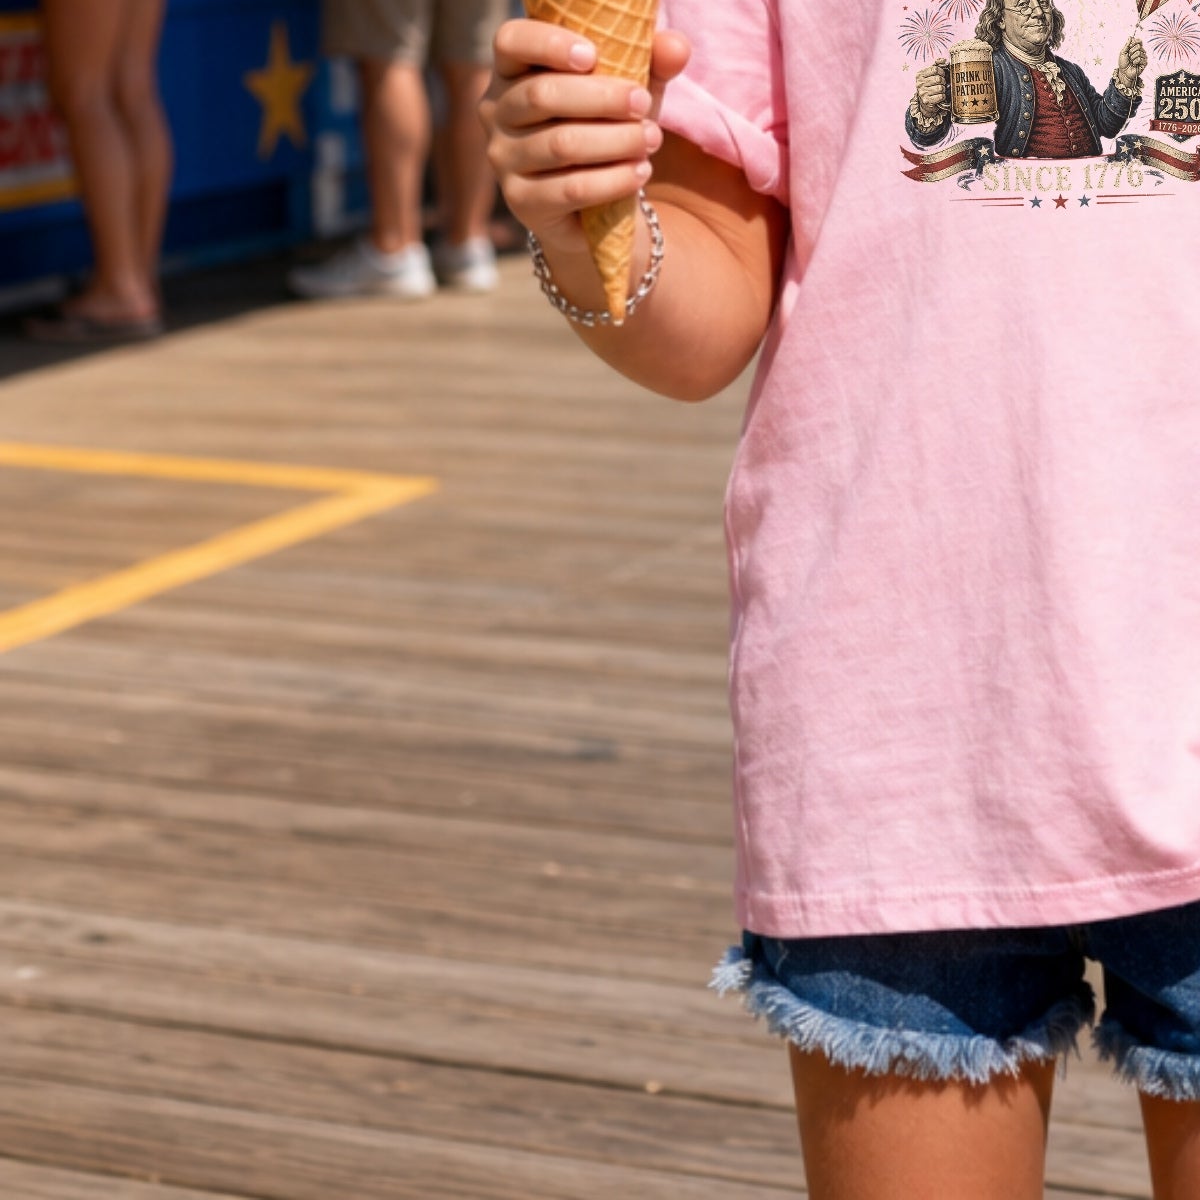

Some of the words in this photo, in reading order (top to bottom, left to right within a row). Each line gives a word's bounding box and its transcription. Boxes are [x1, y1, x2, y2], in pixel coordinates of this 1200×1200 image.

[955, 70, 981, 83] DRINK
[982, 70, 992, 81] UP
[955, 83, 994, 97] PATRIOTS
[982, 164, 1073, 192] SINCE
[1083, 158, 1144, 191] 1776
